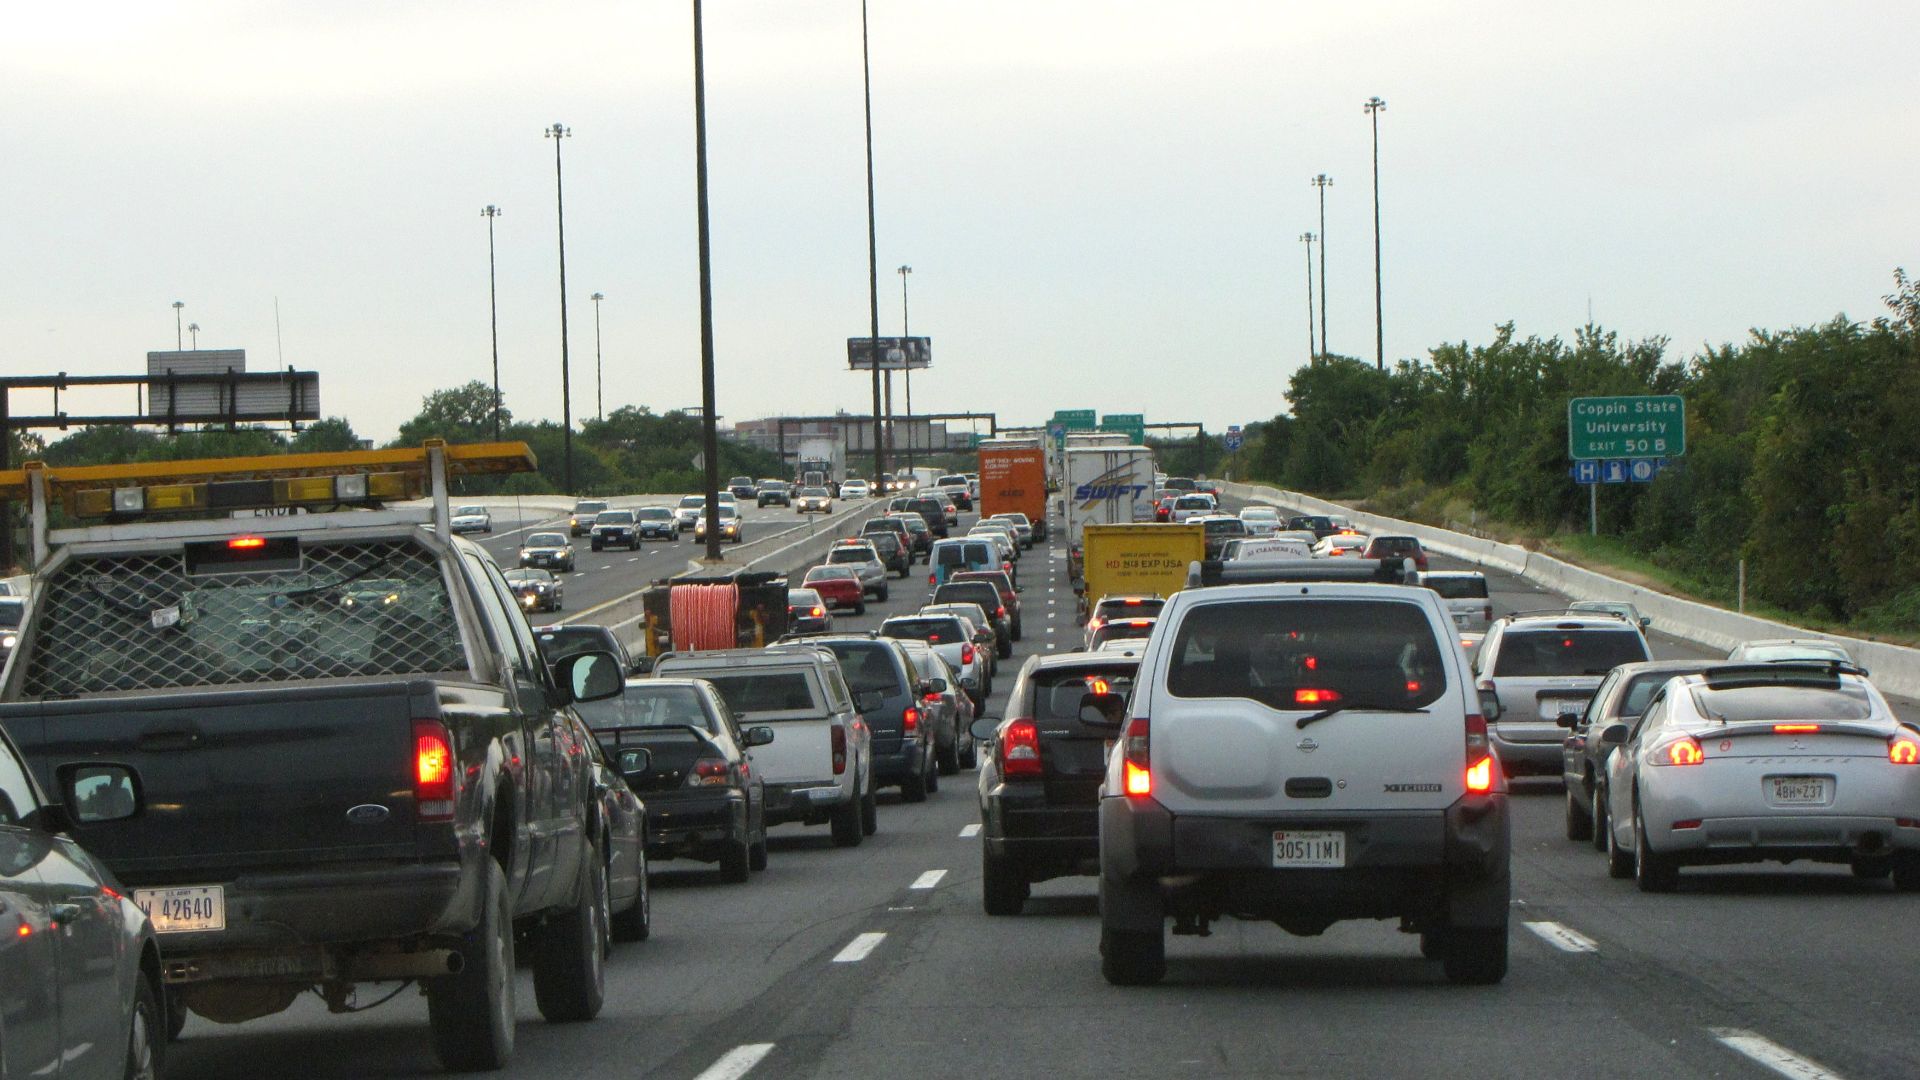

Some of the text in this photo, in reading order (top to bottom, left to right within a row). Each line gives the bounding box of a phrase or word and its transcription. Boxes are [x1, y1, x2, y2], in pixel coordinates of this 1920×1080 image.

[1577, 401, 1677, 415] Coppin State
[1586, 420, 1667, 433] University
[1226, 437, 1241, 448] 95
[1589, 438, 1666, 452] EXIT 50 B
[1580, 463, 1594, 481] H
[1073, 485, 1148, 500] SWIFT
[1141, 560, 1161, 568] EXP
[1163, 560, 1183, 568] USA
[163, 897, 213, 921] 42640
